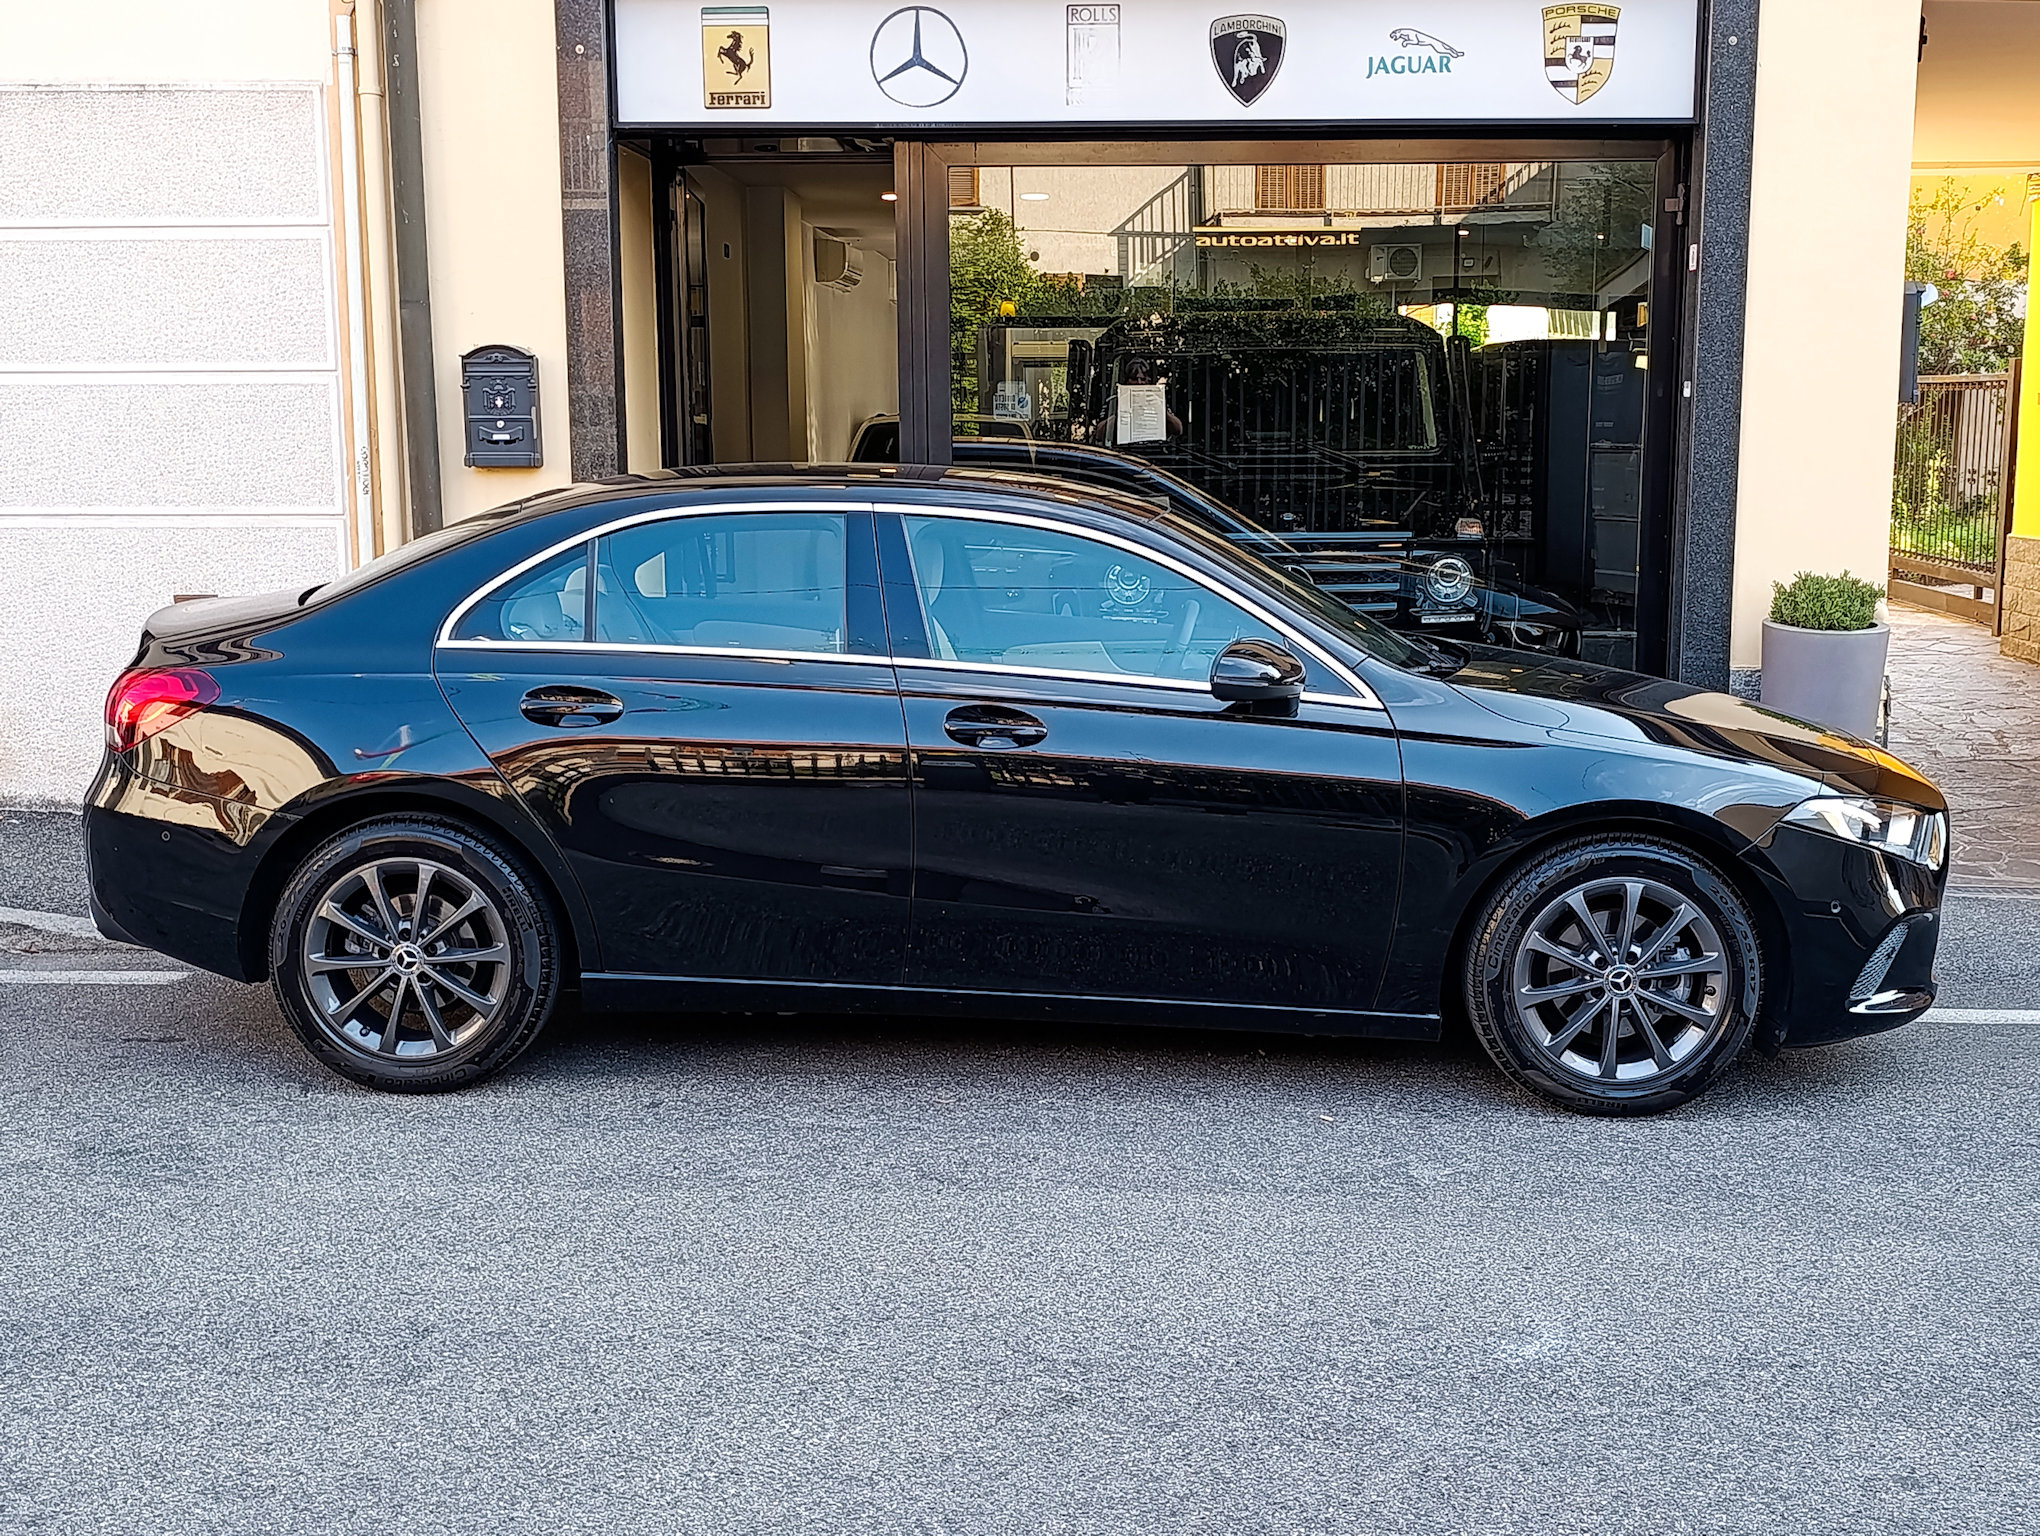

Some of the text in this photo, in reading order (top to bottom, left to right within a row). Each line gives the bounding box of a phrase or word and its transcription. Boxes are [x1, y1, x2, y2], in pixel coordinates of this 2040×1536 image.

[1071, 7, 1117, 22] ROLLS
[1545, 5, 1617, 18] PORSCHE
[1214, 19, 1282, 36] LAMBORGHINI
[1366, 55, 1452, 79] JAGUAR
[709, 91, 766, 105] Ferrari
[1195, 233, 1360, 247] autoattiva.it
[1487, 891, 1534, 970] Cinturato
[1708, 884, 1754, 956] 205/55
[1747, 957, 1757, 996] R17
